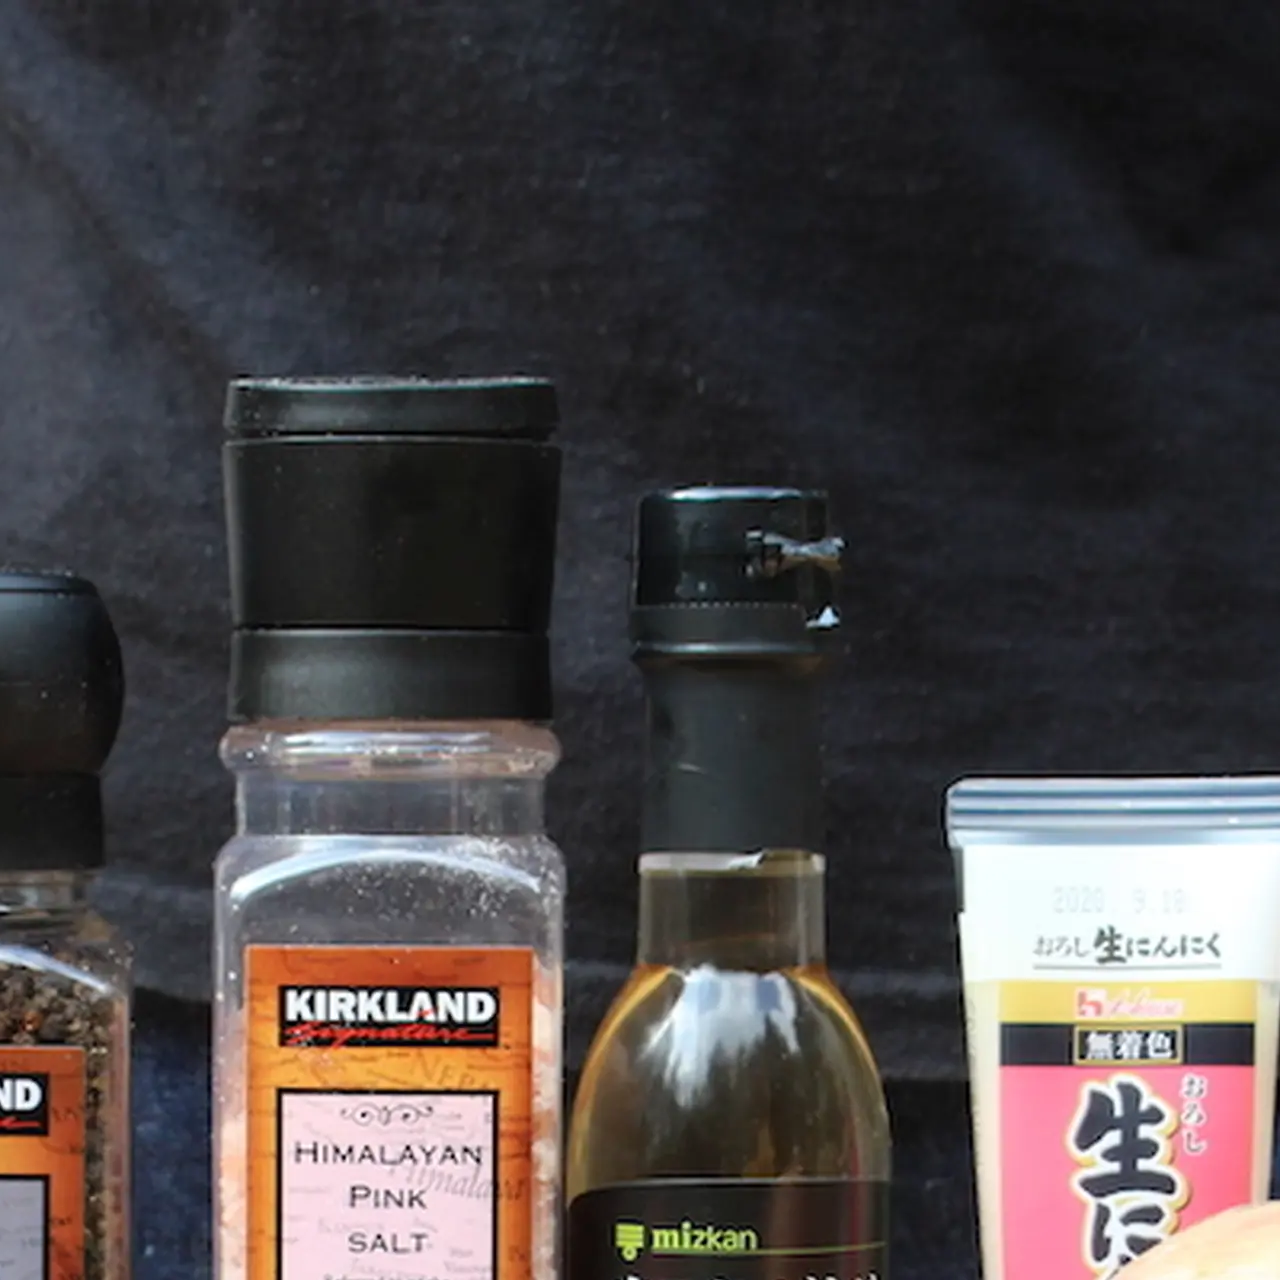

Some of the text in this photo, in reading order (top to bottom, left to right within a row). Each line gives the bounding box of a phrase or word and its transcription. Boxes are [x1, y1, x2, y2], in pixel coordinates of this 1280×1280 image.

[1033, 924, 1221, 964] おろし生にんにく
[286, 989, 496, 1022] KIRKLAND
[284, 1021, 494, 1049] Signature
[1183, 1075, 1206, 1153] おろし
[294, 1142, 483, 1165] HIMALAYAN
[348, 1185, 428, 1210] PINK
[348, 1233, 428, 1254] SALT
[652, 1222, 757, 1249] mizkan
